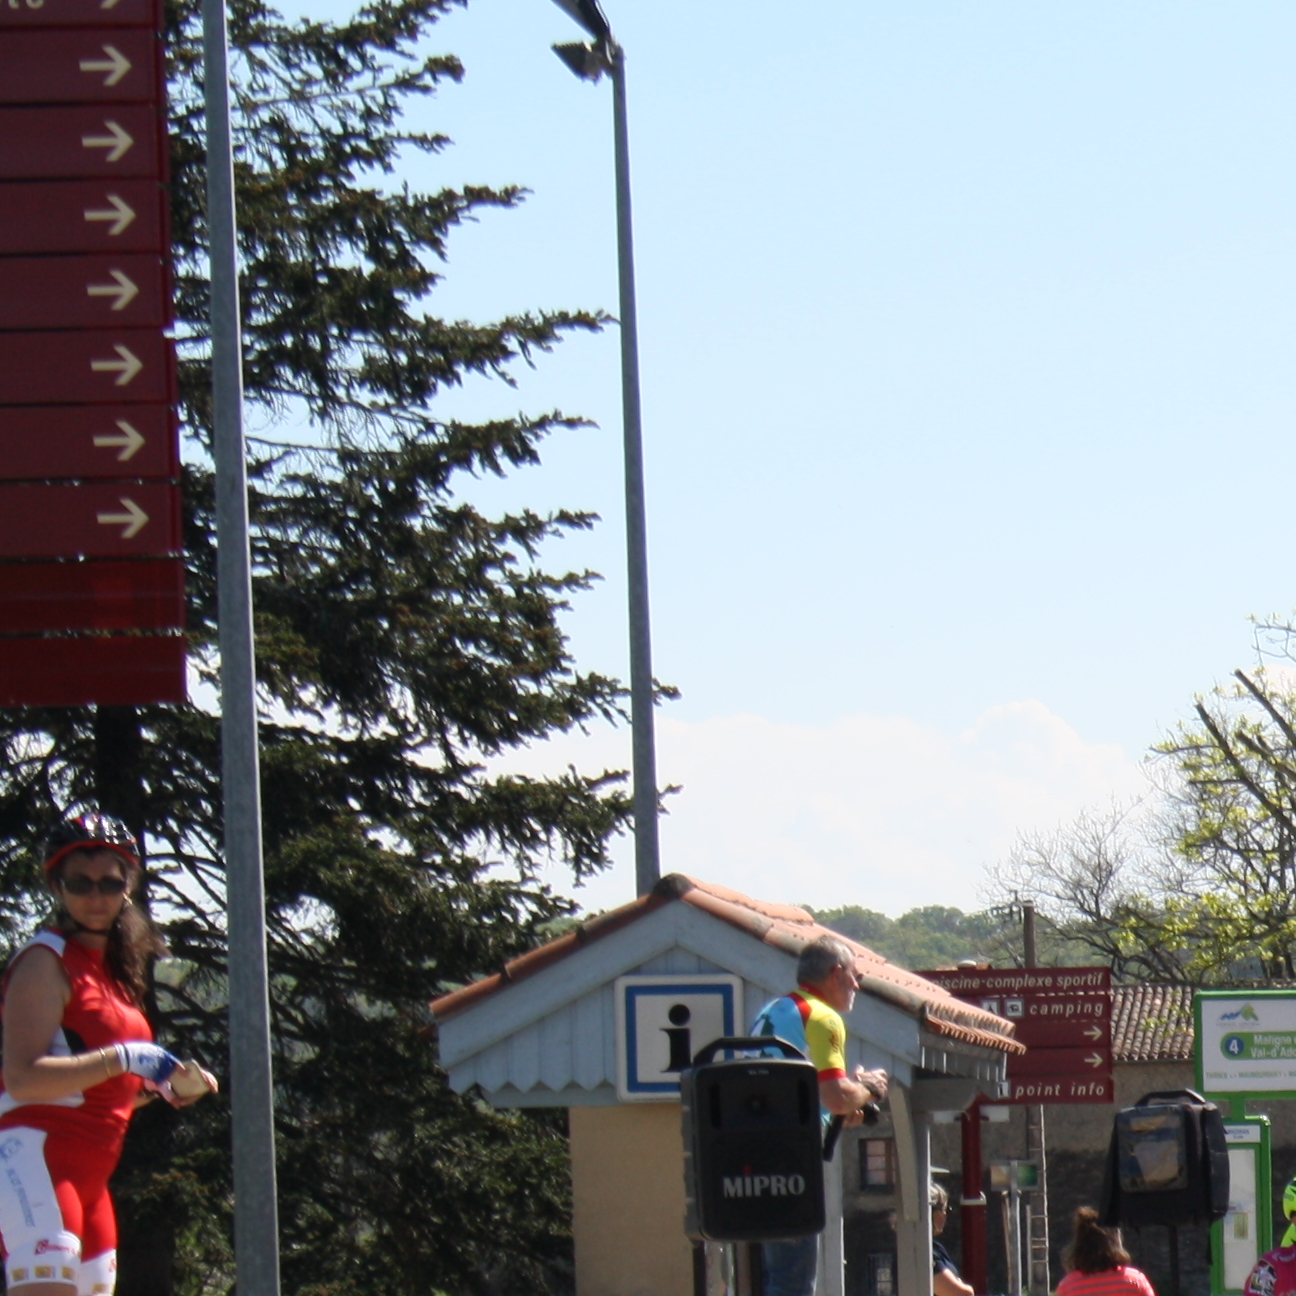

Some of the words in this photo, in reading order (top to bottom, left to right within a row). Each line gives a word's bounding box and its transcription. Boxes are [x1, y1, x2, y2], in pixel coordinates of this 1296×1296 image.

[1056, 972, 1104, 990] sportif
[1029, 1001, 1104, 1018] camping
[1229, 1039, 1239, 1055] 4
[1015, 1081, 1061, 1099] point
[1070, 1081, 1105, 1097] info
[723, 1173, 806, 1198] MIPRO
